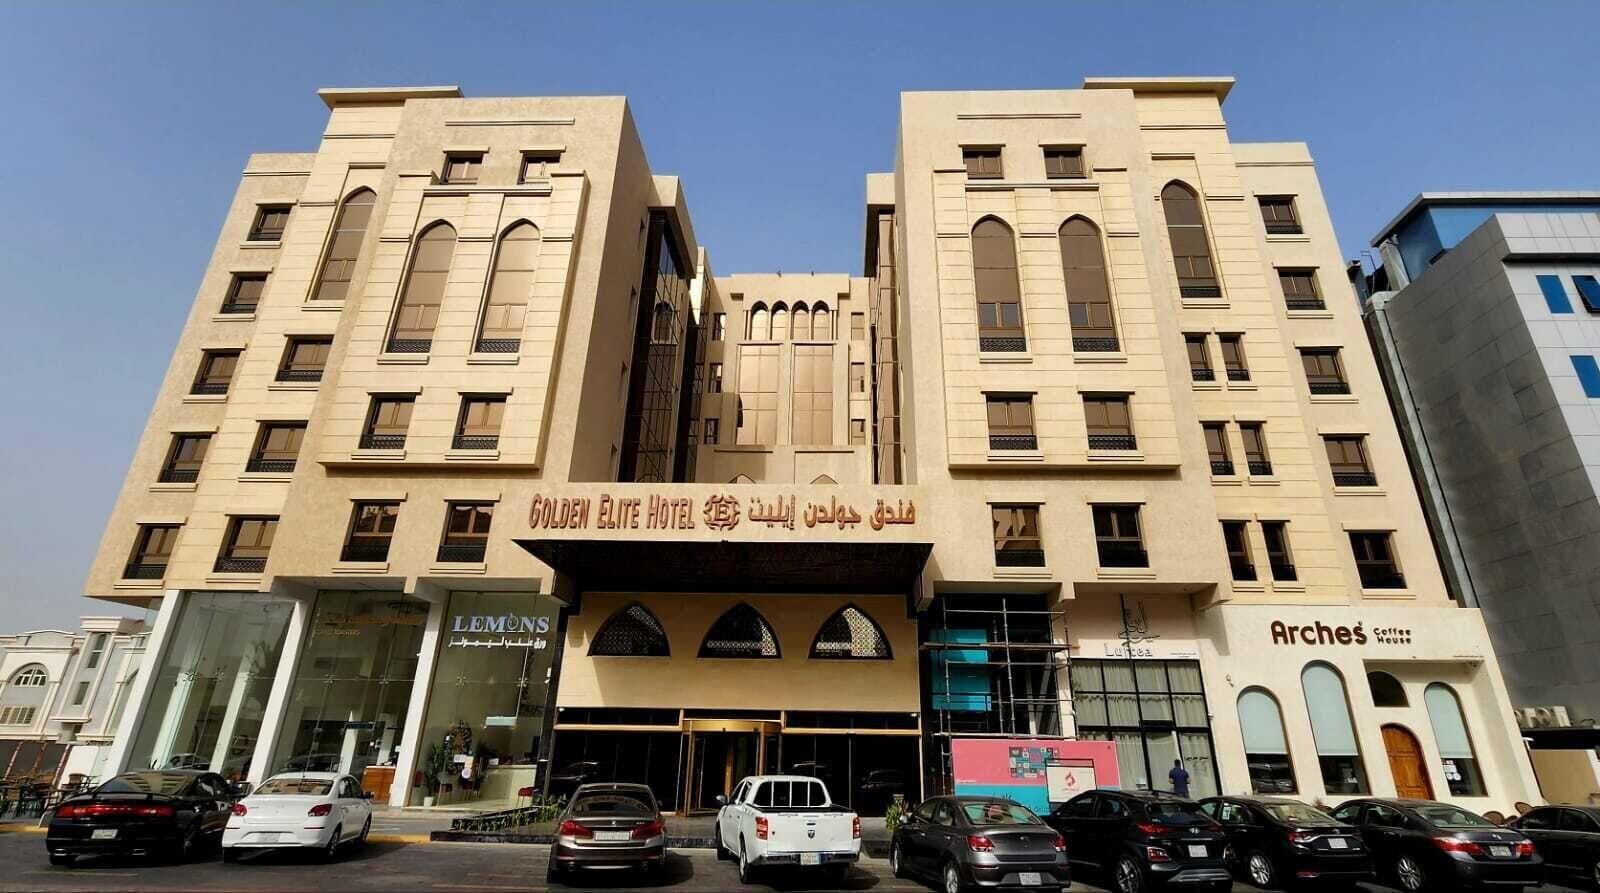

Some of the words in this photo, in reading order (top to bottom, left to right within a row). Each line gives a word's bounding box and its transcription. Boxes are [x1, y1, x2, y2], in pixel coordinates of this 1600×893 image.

[528, 493, 591, 530] GOLDEN
[597, 493, 641, 530] ELITE
[646, 493, 695, 530] HOTEL
[748, 494, 796, 531] إيليت
[803, 495, 861, 530] جولدن
[869, 498, 916, 531] فندق
[452, 613, 550, 633] LEMONS
[1373, 627, 1412, 636] Coffee
[1377, 636, 1412, 645] House
